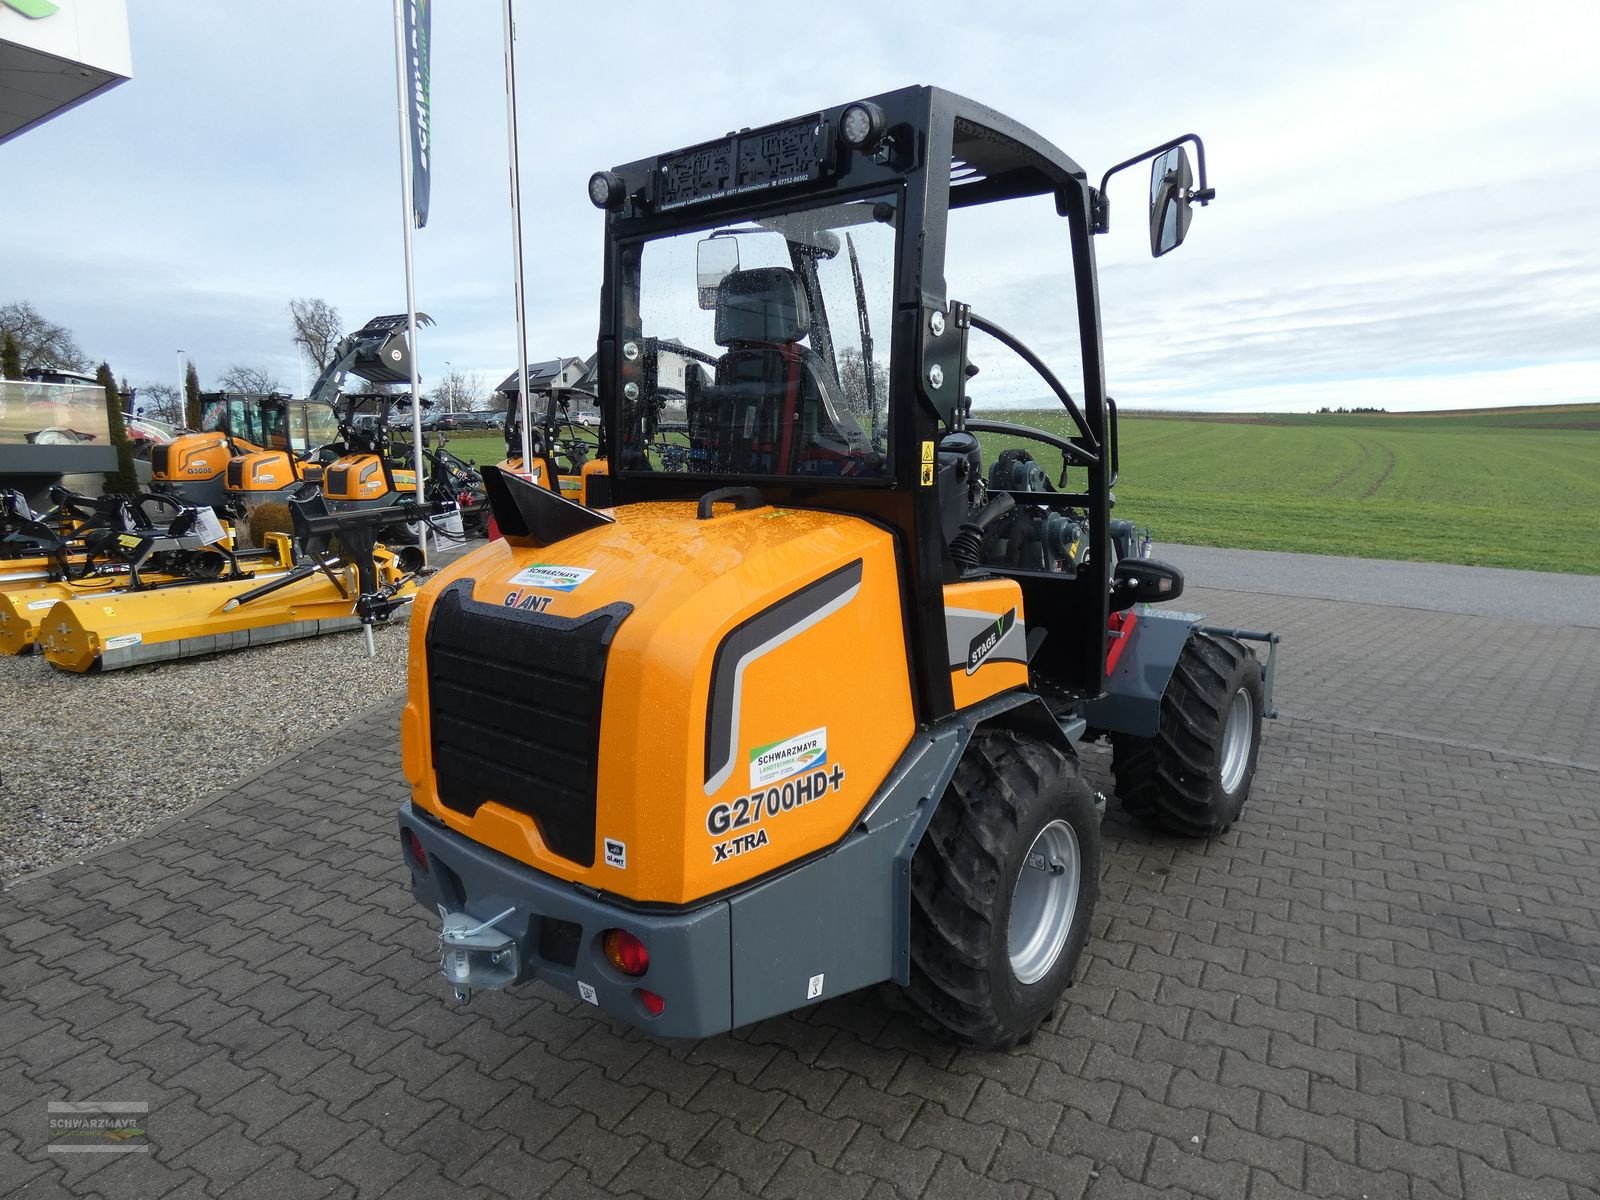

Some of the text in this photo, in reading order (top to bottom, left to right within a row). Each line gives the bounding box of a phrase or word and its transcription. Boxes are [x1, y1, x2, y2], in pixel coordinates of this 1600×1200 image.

[711, 191, 725, 199] GmbH
[726, 188, 737, 196] 4971
[187, 467, 213, 475] G5000
[528, 567, 580, 579] SCHWARZMAYR
[972, 632, 996, 662] STAGE
[758, 739, 818, 766] SCHWARZMAYR
[759, 757, 796, 774] LANDTECHNIK
[706, 764, 845, 836] G2700HD+
[713, 828, 769, 864] X-TRA
